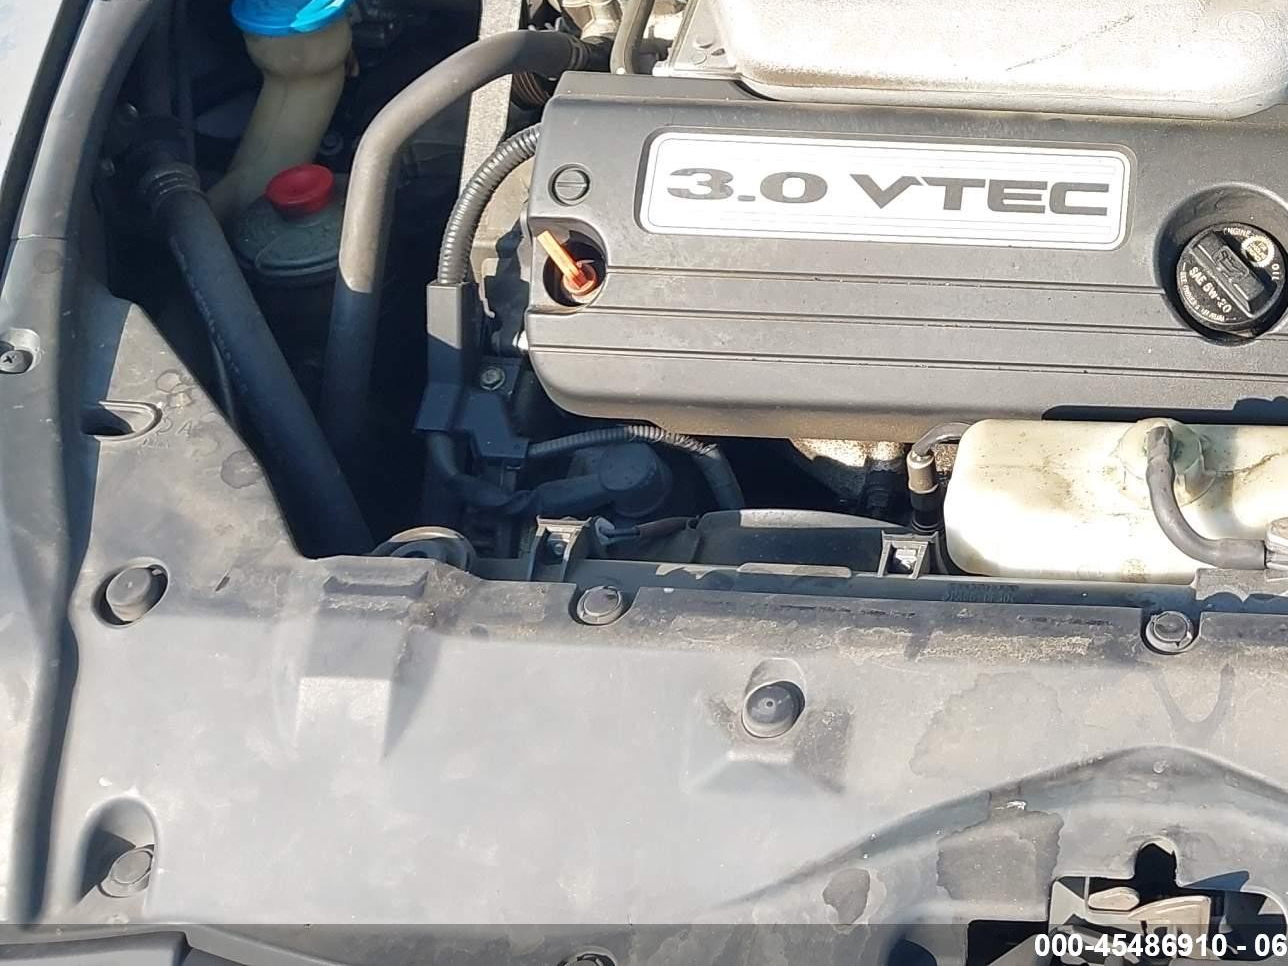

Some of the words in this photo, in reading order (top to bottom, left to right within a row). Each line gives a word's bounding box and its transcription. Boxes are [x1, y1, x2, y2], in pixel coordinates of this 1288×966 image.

[667, 167, 829, 204] 3.0
[850, 173, 1110, 217] VTEC
[1188, 266, 1207, 288] SAE
[1201, 281, 1232, 313] 5W-20
[1271, 263, 1280, 281] OIL
